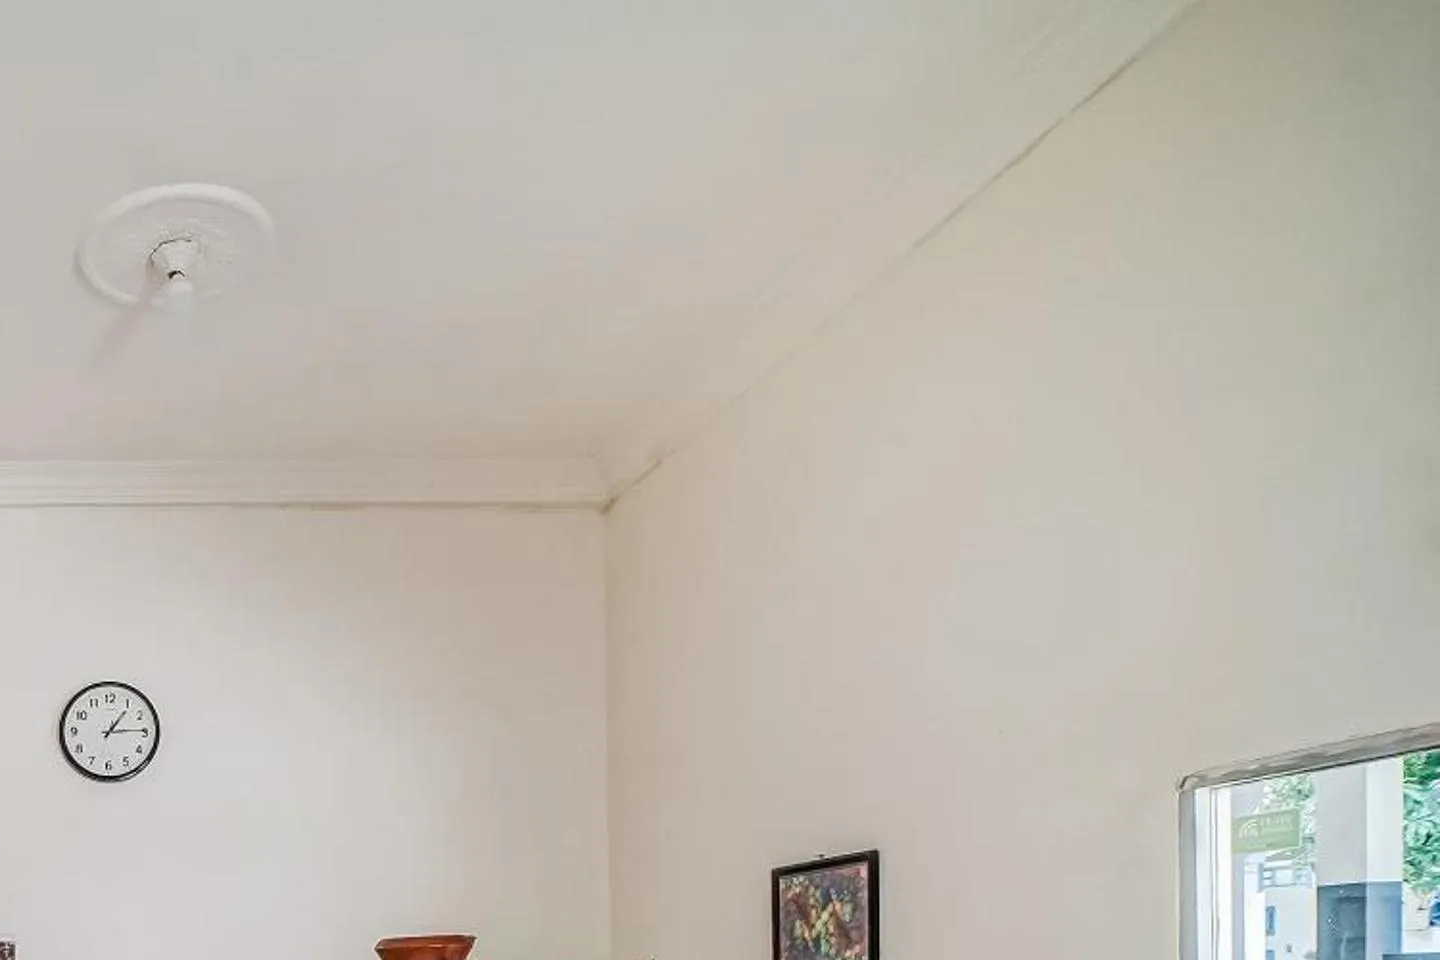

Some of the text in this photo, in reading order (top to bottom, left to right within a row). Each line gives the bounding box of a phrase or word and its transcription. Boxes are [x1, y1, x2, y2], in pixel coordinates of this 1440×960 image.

[105, 693, 116, 703] 12
[90, 699, 98, 708] 11
[76, 710, 87, 720] 10
[137, 710, 143, 720] 2
[71, 727, 78, 736] 9
[141, 728, 148, 738] 3
[136, 744, 142, 753] 4
[89, 757, 96, 765] 7
[105, 760, 112, 770] 6
[122, 756, 129, 767] 5
